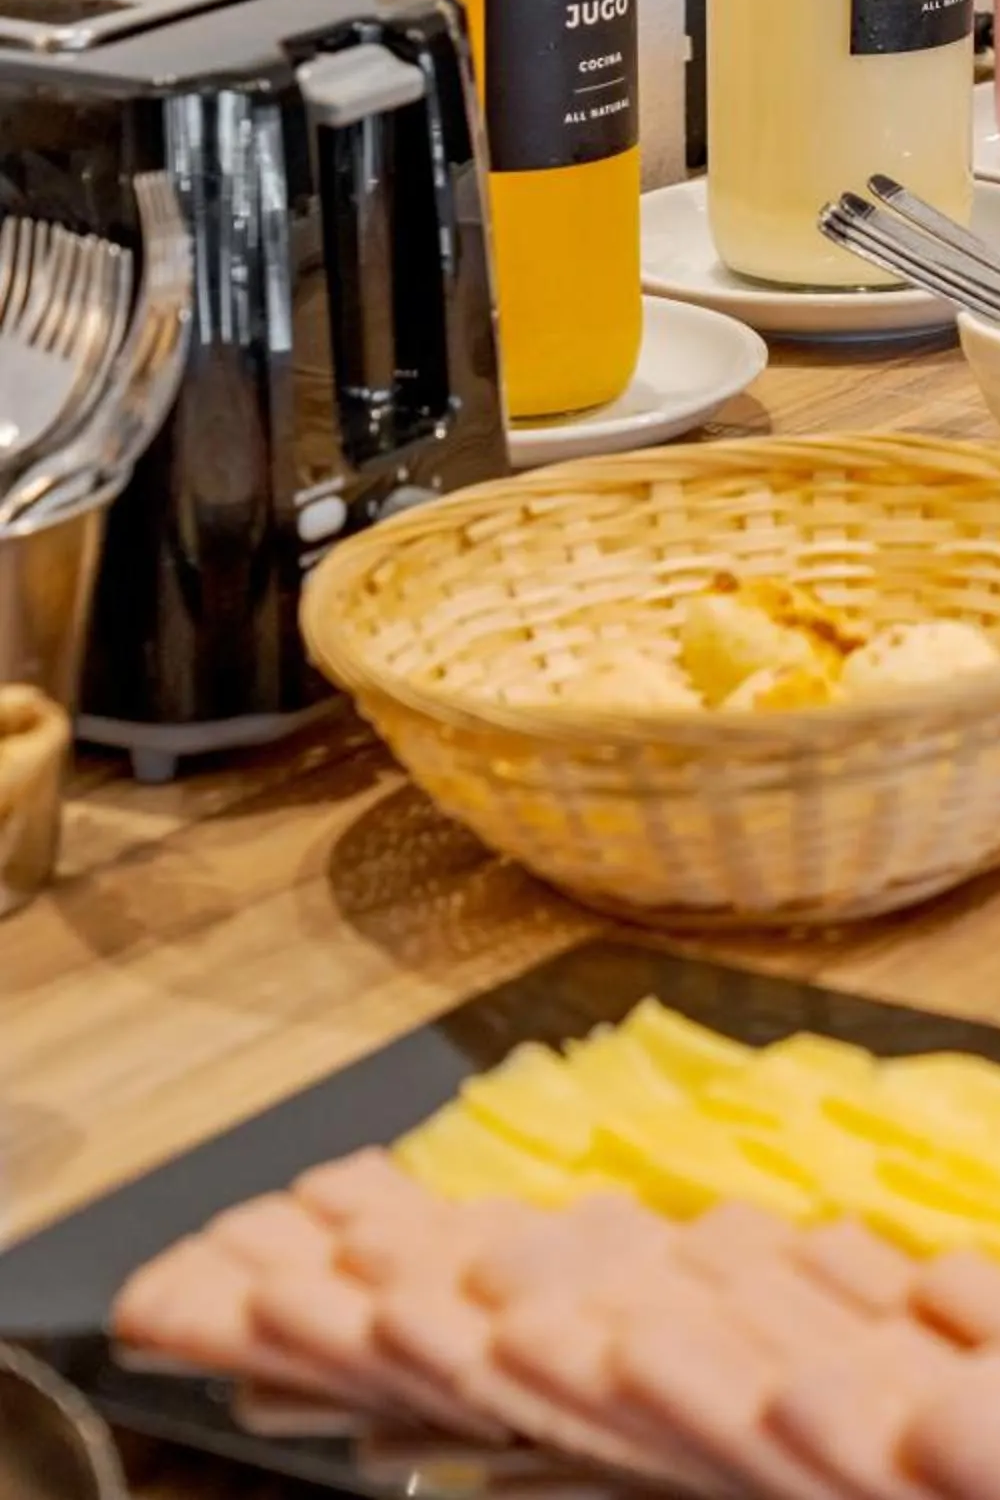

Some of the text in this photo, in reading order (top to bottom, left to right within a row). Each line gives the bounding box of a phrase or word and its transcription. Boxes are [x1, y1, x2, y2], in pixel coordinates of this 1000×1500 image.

[922, 1, 941, 12] ALL
[579, 51, 622, 73] COCINA
[564, 97, 630, 124] ALL NATURAL
